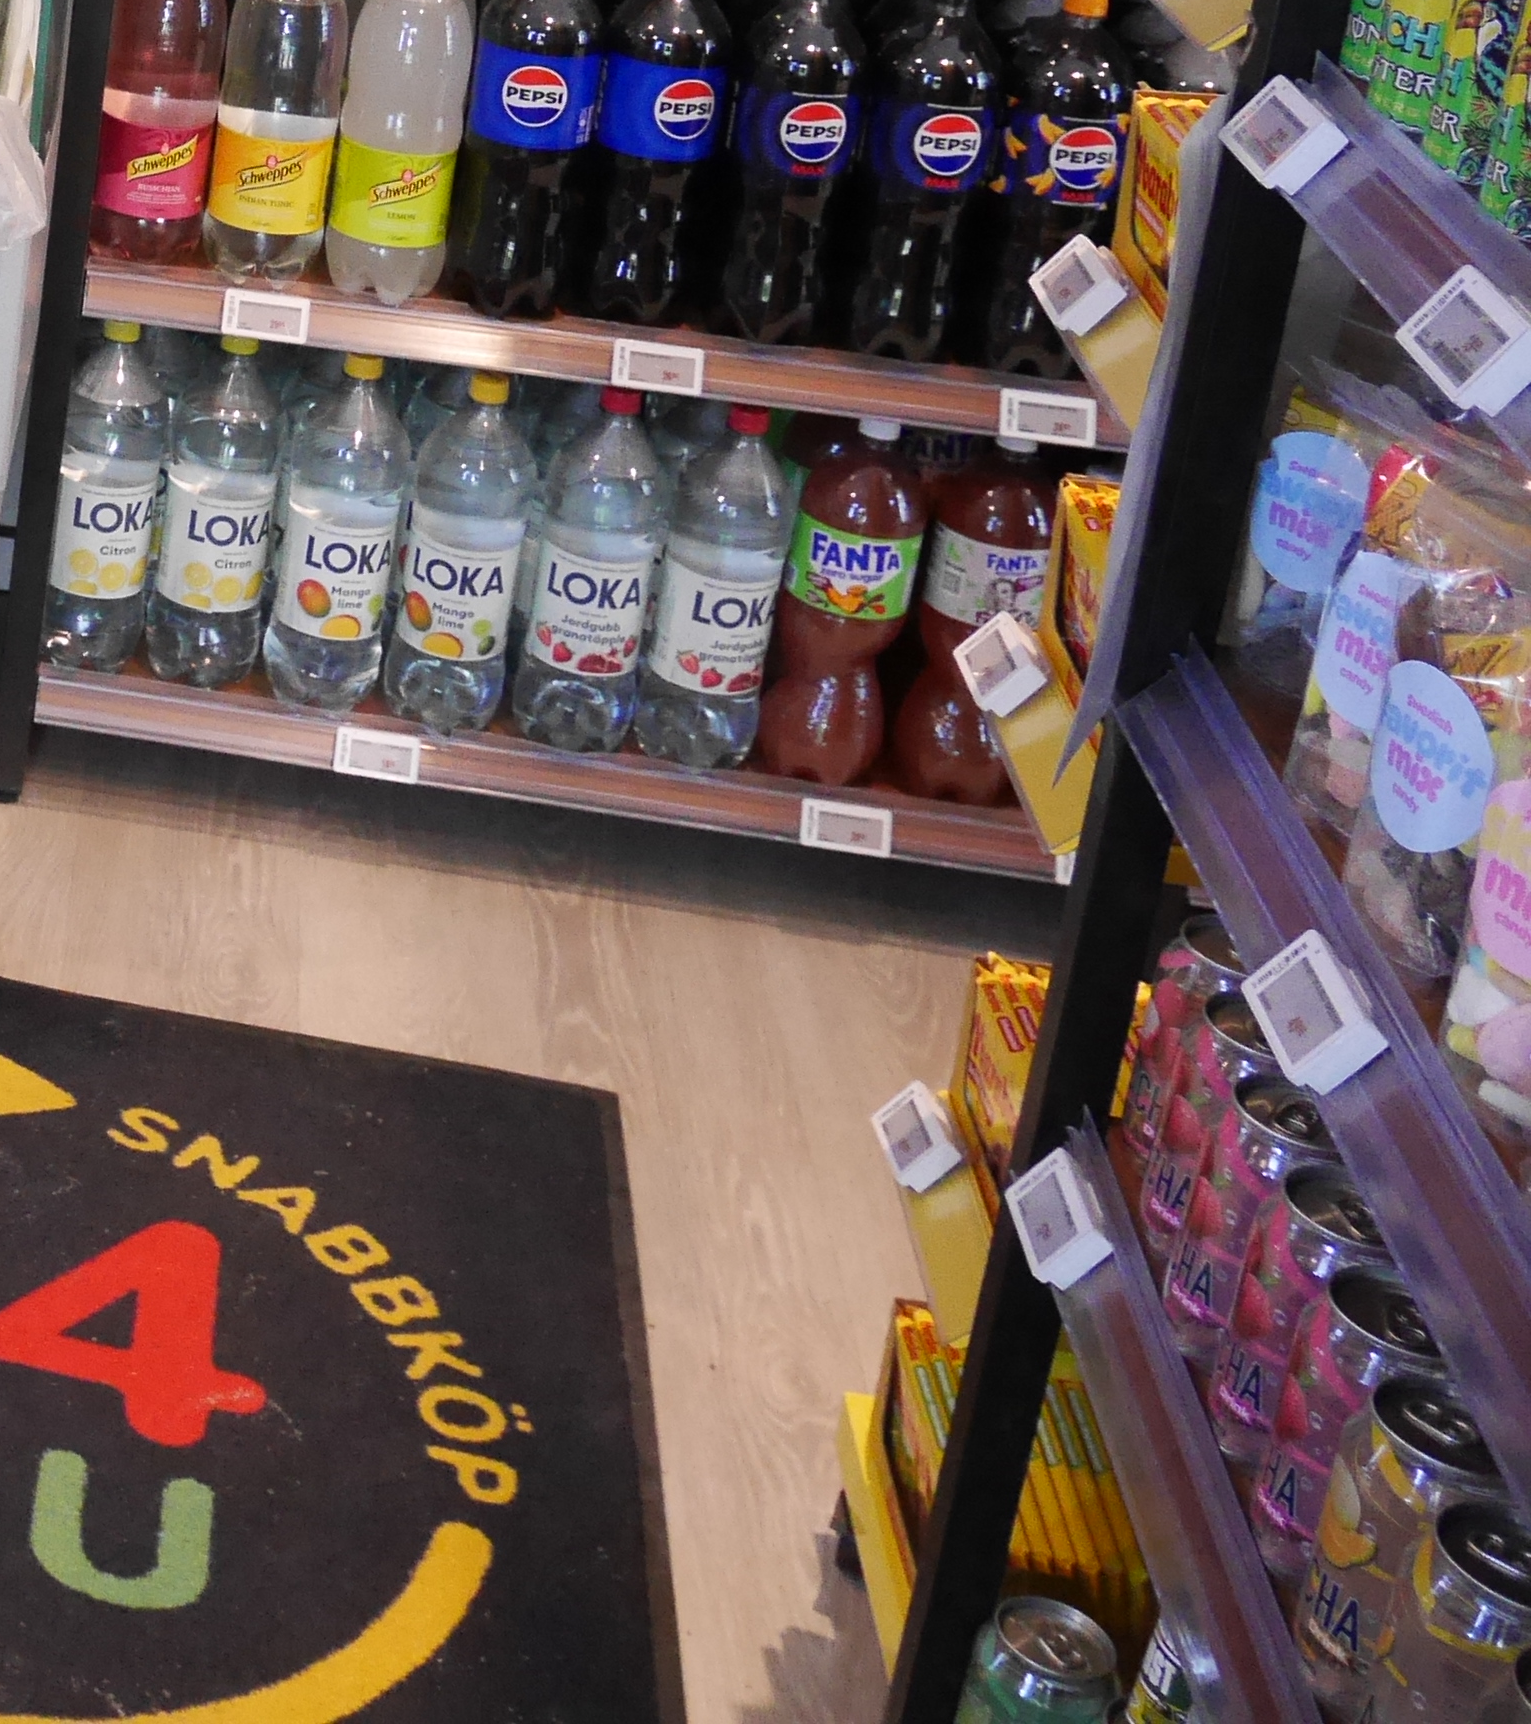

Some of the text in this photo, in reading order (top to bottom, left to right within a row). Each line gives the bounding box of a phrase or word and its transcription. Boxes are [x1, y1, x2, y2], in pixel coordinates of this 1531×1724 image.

[506, 85, 563, 106] PEPSI
[659, 100, 712, 118] PEPSI
[785, 123, 844, 140] PEPSI
[919, 136, 977, 152] PEPSI
[128, 140, 195, 177] Schweppes
[1054, 149, 1114, 167] PEPSI
[238, 158, 304, 188] Schweppes
[370, 171, 437, 203] Schweppes
[73, 496, 155, 533] LOKA
[187, 509, 270, 548] LOKA
[100, 545, 138, 557] Citron
[304, 535, 392, 576] LOKA
[811, 531, 901, 575] FANTA
[215, 559, 253, 570] Citron
[413, 547, 505, 598] LOKA
[986, 552, 1038, 573] FANTA
[331, 586, 372, 598] Mango
[547, 561, 641, 610] LOKA
[337, 599, 363, 610] lime
[432, 602, 475, 620] Mango
[438, 617, 465, 630] lime
[1386, 738, 1444, 803] mix
[107, 1106, 534, 1505] SNABBKÖP
